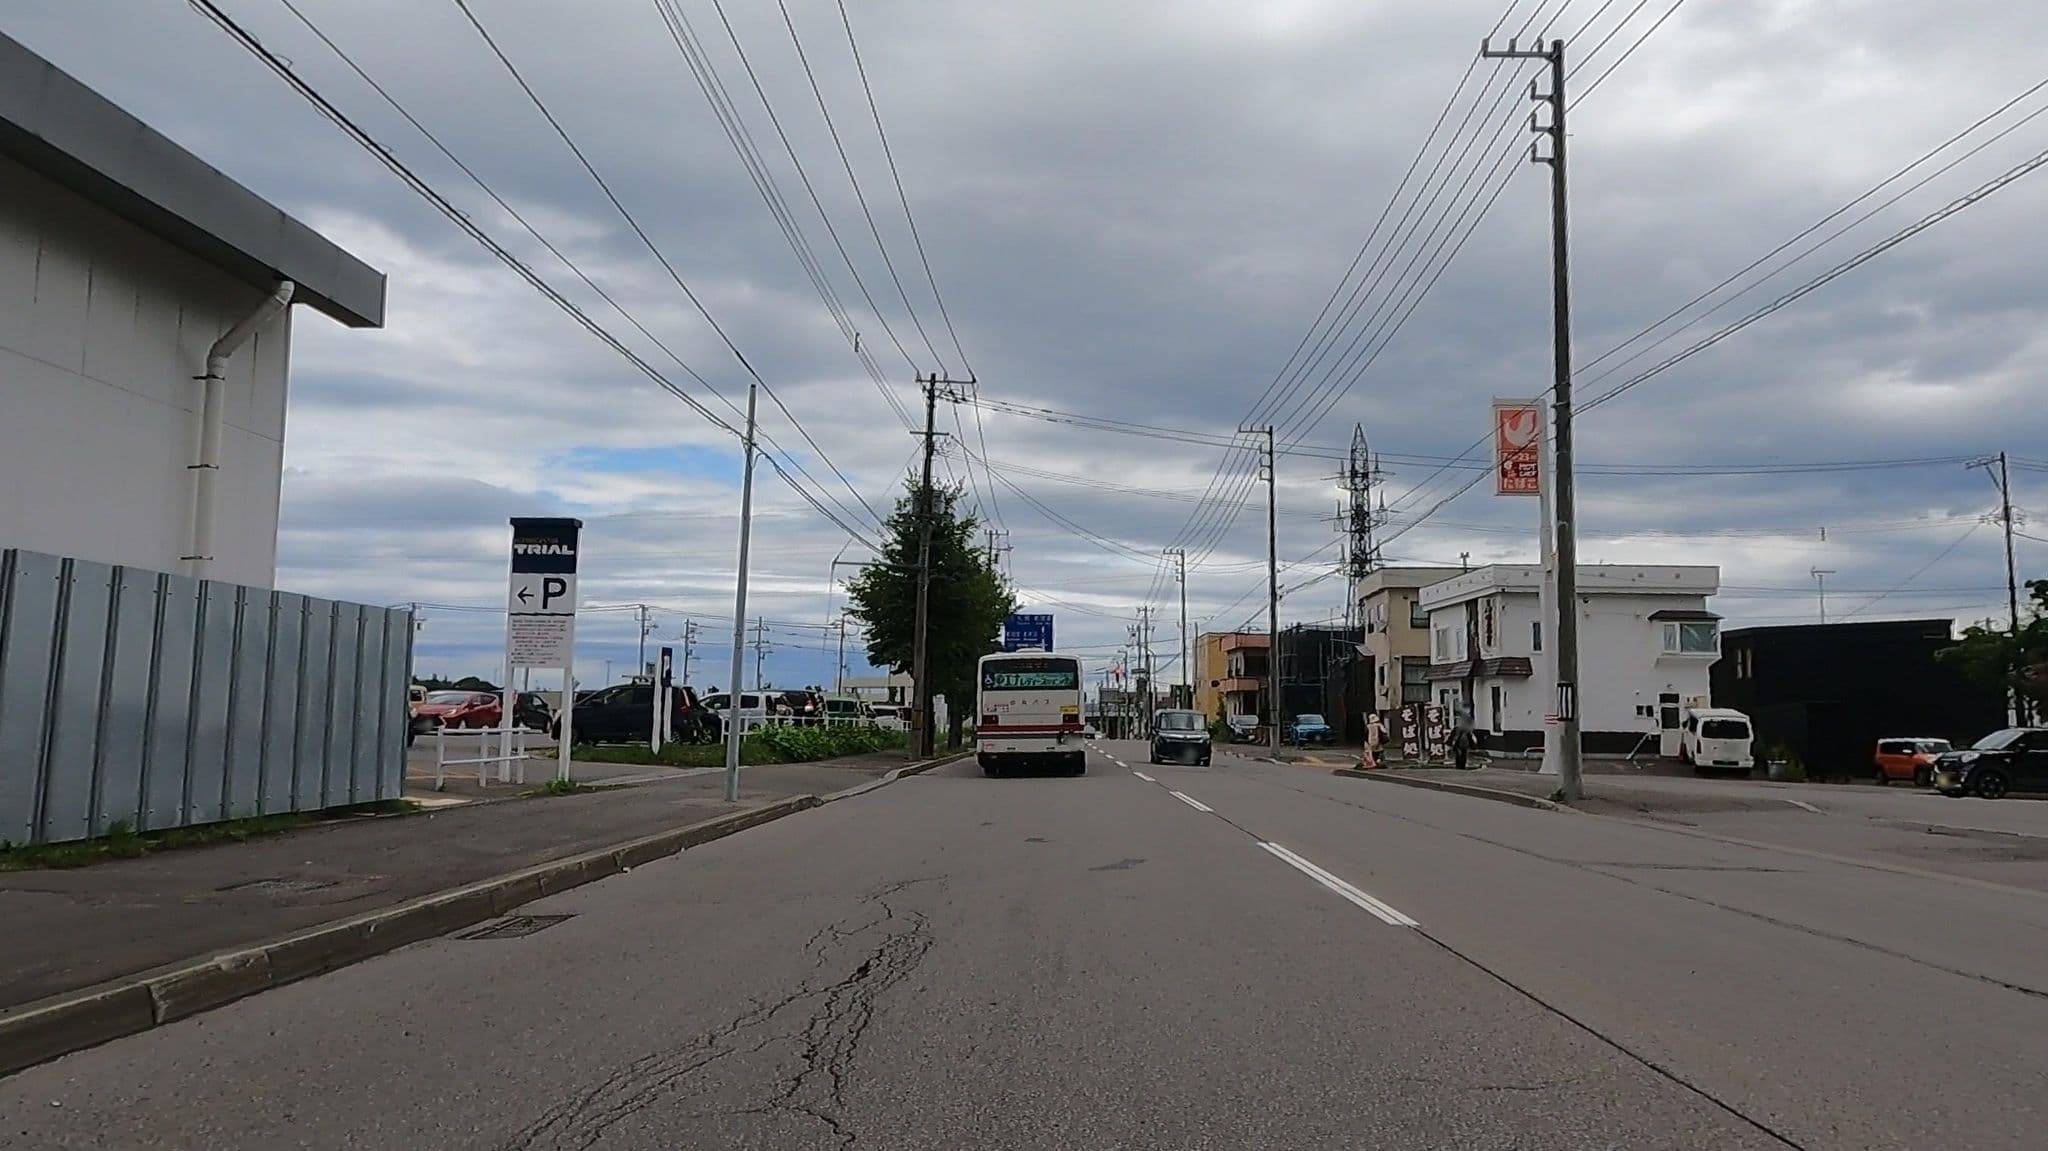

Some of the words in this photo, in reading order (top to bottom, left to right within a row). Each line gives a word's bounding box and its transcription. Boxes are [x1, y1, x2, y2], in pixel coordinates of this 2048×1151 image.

[1503, 477, 1537, 489] たばこ
[514, 544, 575, 555] TRIAL
[542, 577, 567, 610] P
[1401, 708, 1419, 756] そば処
[1427, 708, 1444, 756] そば処
